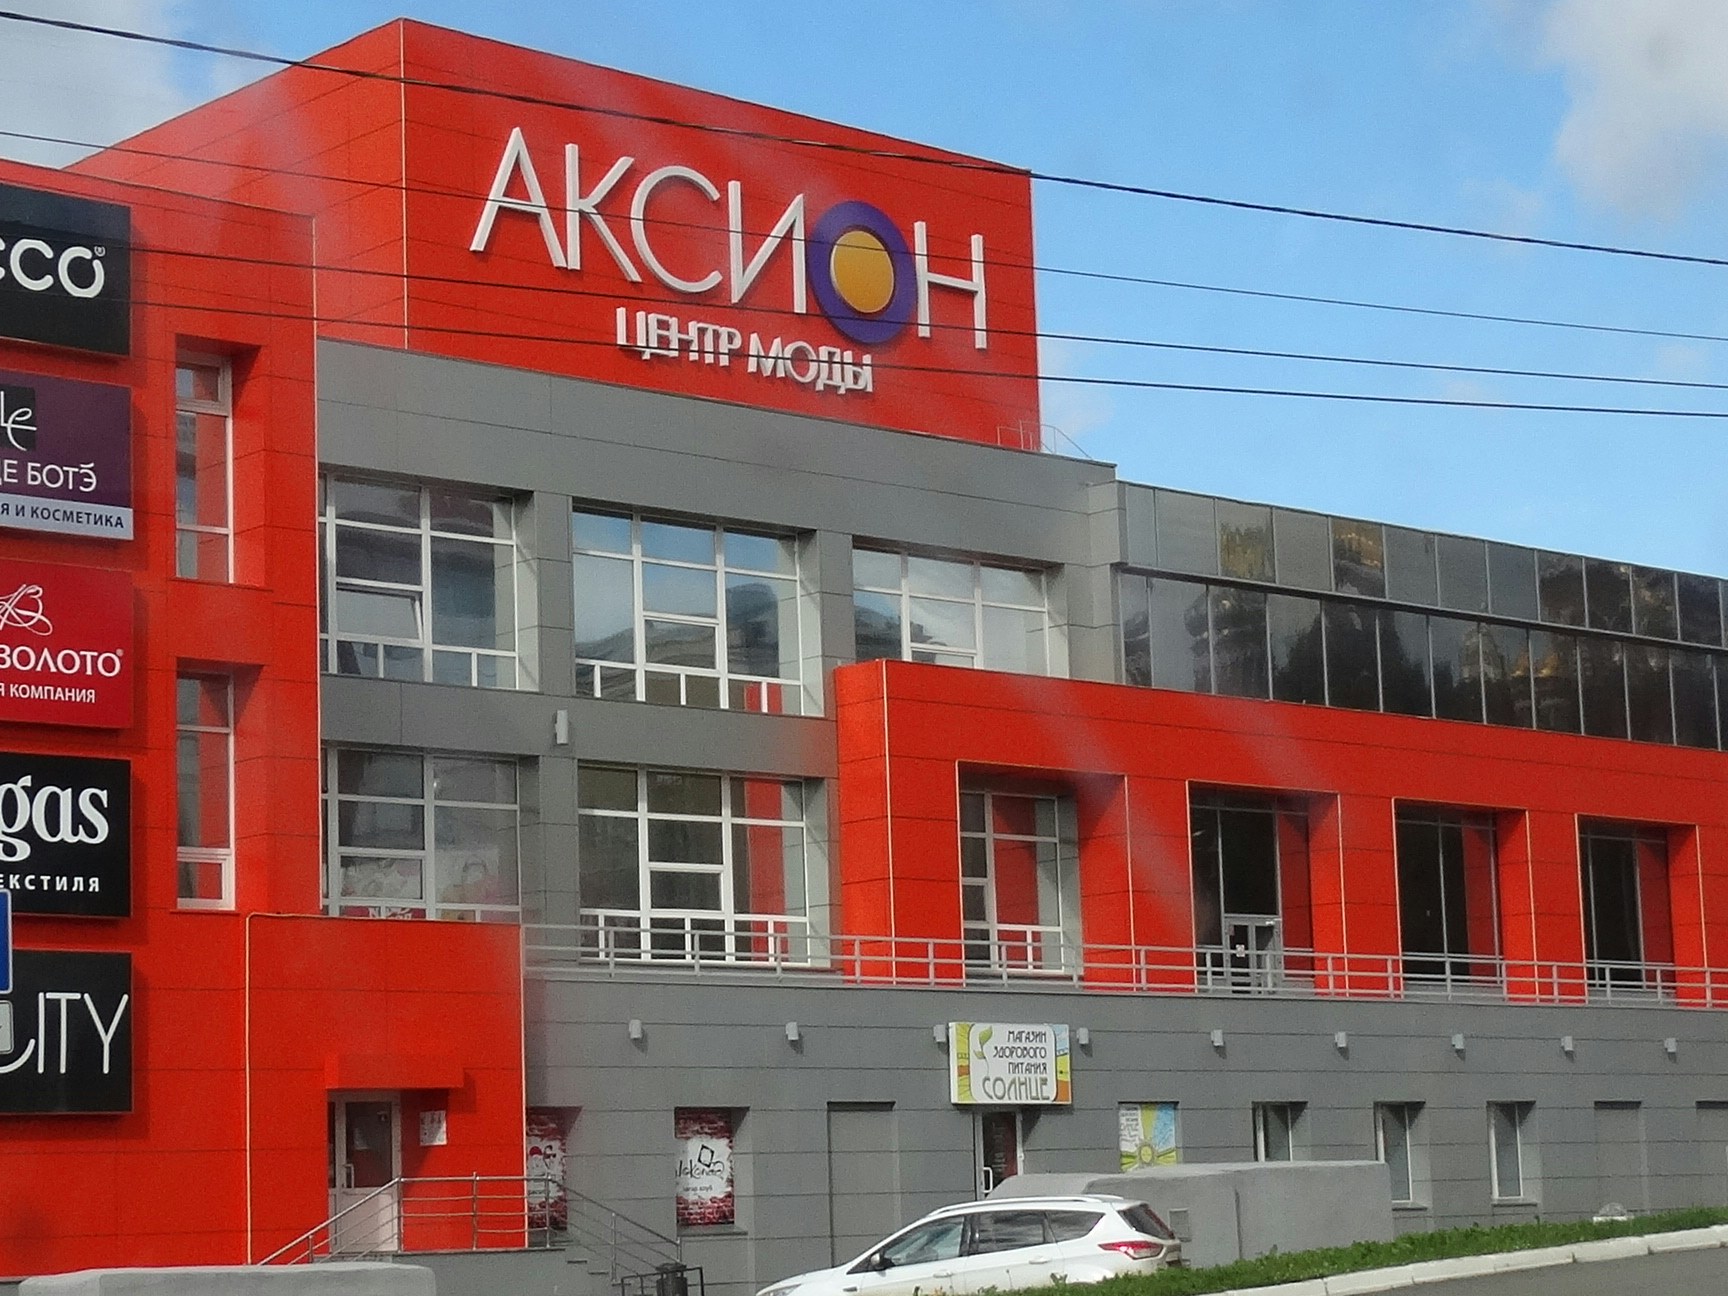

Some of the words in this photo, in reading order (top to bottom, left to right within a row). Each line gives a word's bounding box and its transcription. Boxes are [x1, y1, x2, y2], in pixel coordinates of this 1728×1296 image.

[470, 127, 987, 349] АКСИОН
[615, 307, 742, 367] ЦЕНТР
[748, 333, 874, 394] МОДЫ
[15, 504, 25, 517] И
[30, 506, 124, 529] КОСМЕТИКА
[10, 683, 96, 704] КОМПАНИЯ
[1007, 1030, 1047, 1043] МАГАЗИН
[993, 1046, 1047, 1059] ЗДОРОВОГО
[1008, 1062, 1048, 1075] ПИТАНИЯ
[982, 1075, 1050, 1101] СОЛНЦЕ
